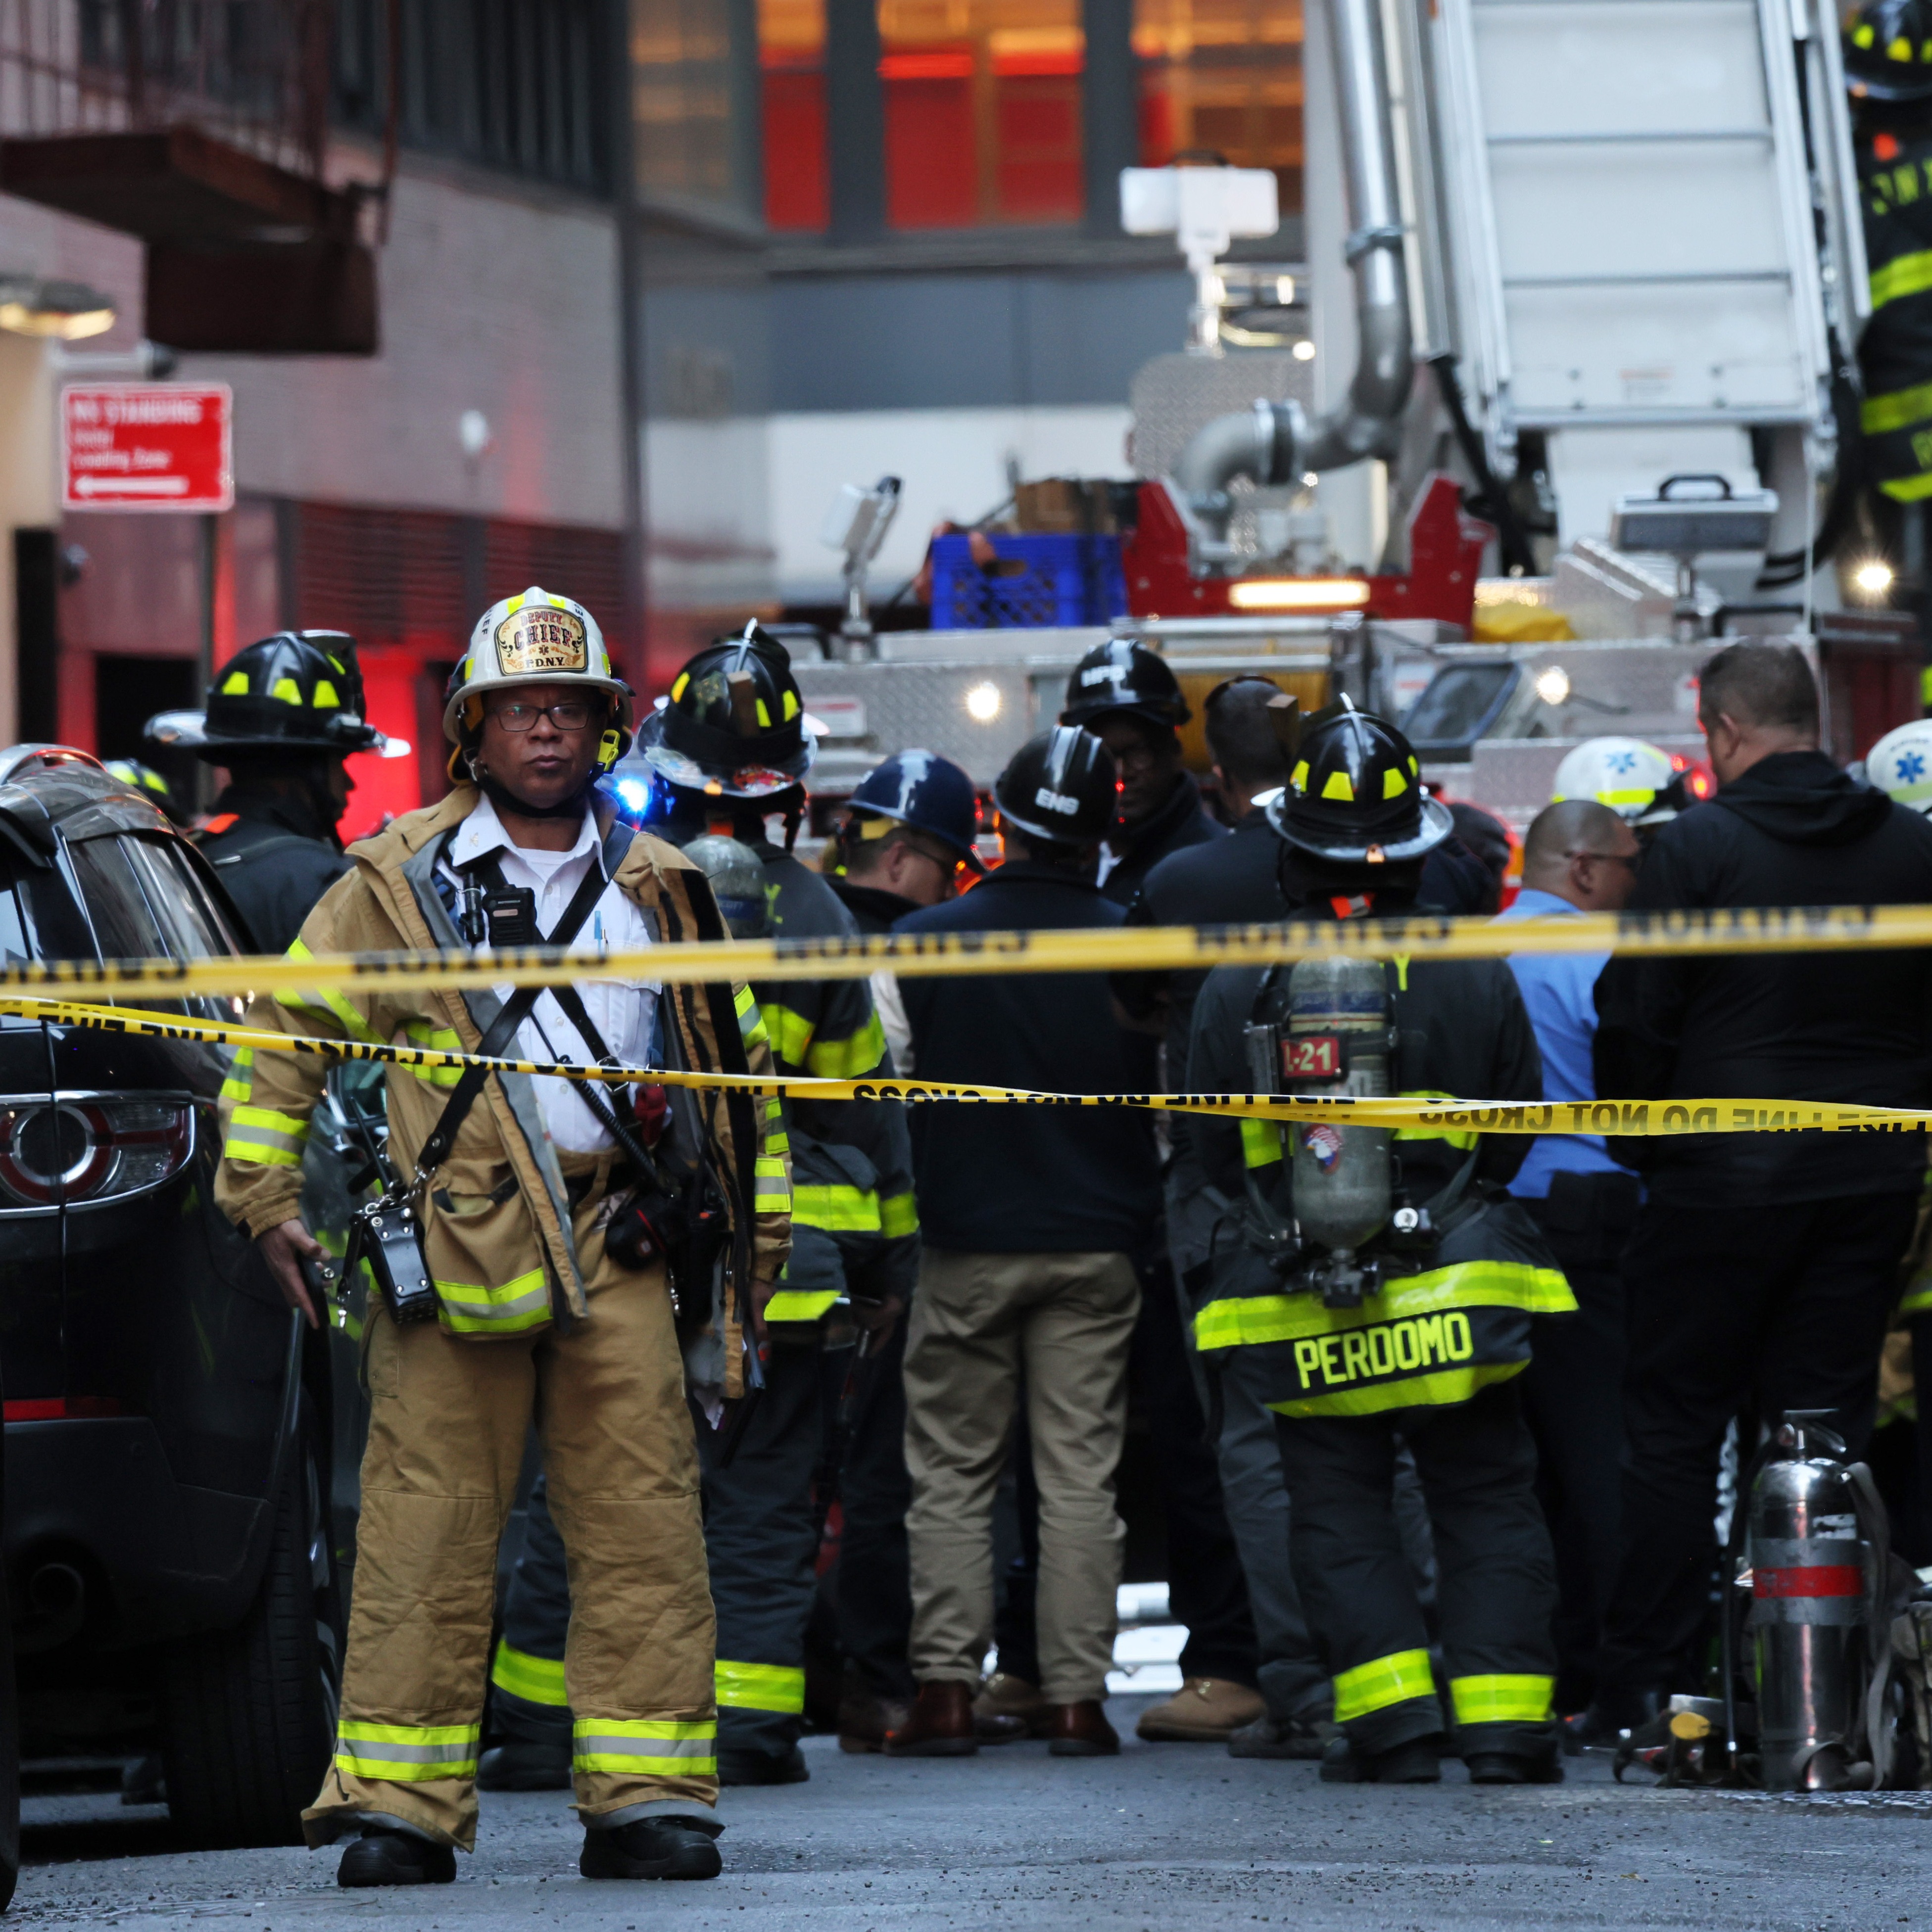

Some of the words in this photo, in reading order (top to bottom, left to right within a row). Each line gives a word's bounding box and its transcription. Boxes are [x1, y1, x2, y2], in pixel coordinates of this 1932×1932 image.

[520, 611, 563, 626] DEPUTY
[514, 623, 573, 651] CHIEF
[1293, 1312, 1474, 1389] PERDOMO
